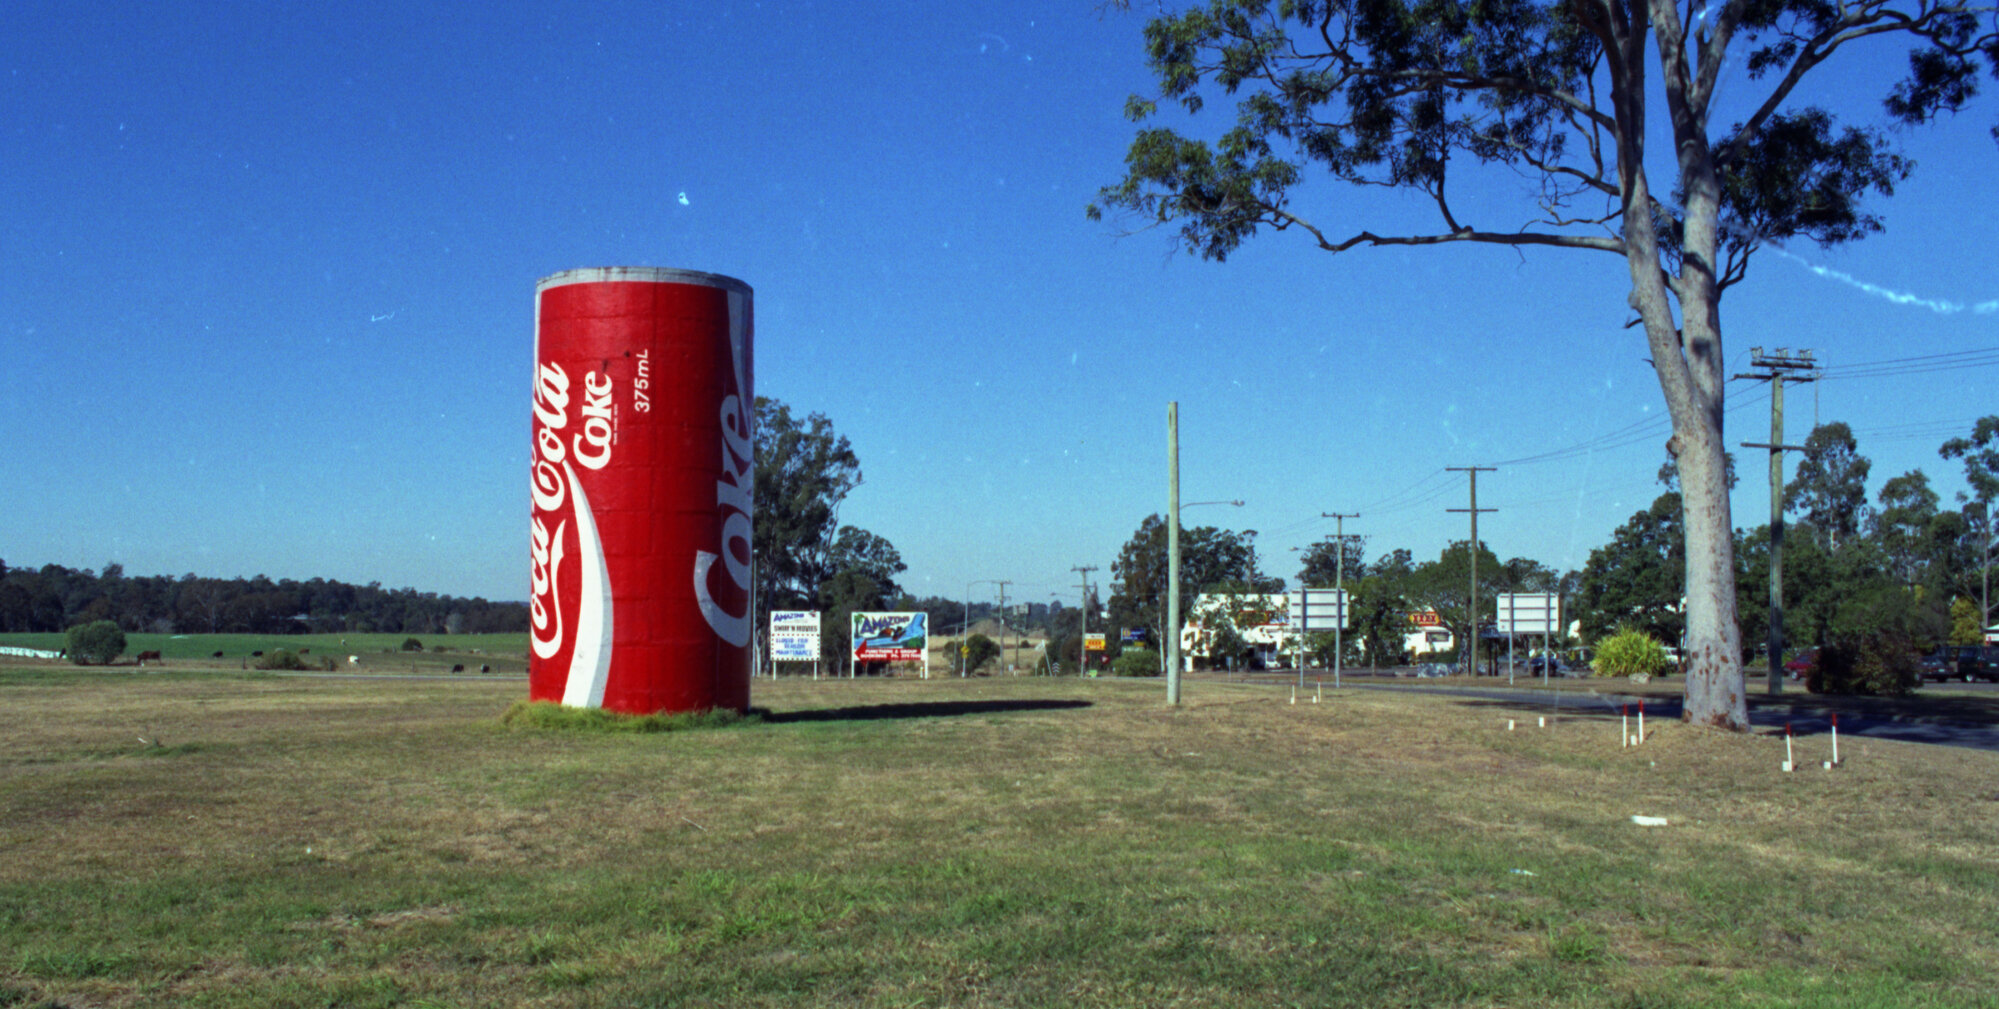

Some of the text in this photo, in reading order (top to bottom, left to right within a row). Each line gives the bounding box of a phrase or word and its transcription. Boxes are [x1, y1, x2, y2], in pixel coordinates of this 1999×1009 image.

[573, 371, 613, 470] Coke
[634, 349, 650, 413] 375mL
[693, 394, 754, 648] Coke
